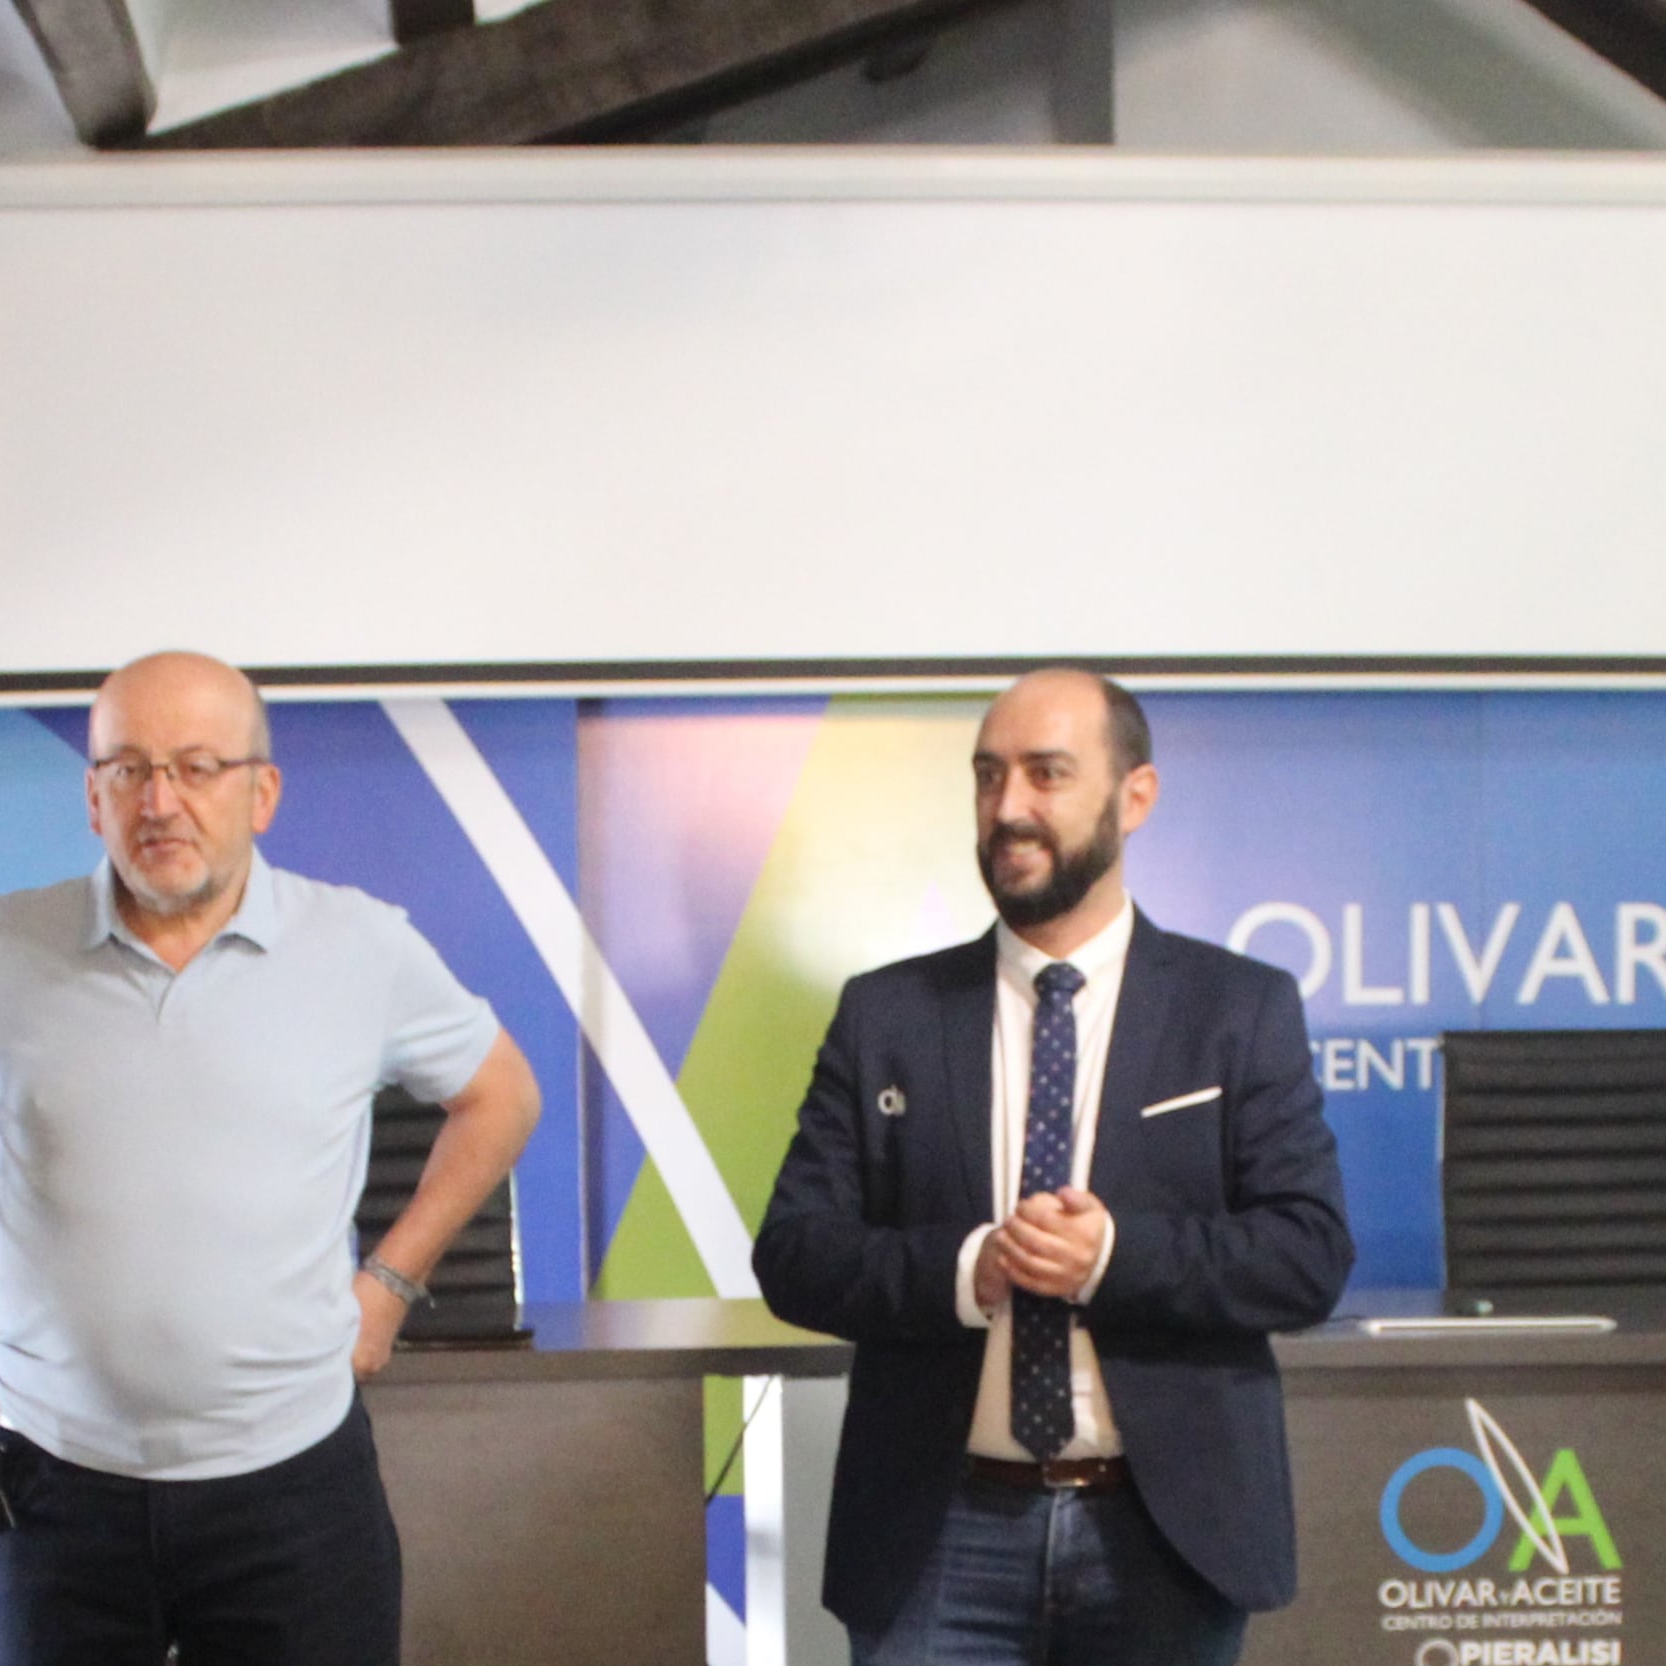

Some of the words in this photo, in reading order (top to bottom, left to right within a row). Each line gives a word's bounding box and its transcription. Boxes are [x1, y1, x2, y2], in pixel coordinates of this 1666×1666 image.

[1310, 1037, 1442, 1091] ENT
[1380, 1448, 1623, 1573] OA
[1379, 1580, 1497, 1608] OLIVAR
[1511, 1577, 1622, 1606] ACEITE
[1381, 1613, 1452, 1631] CENTRO
[1456, 1612, 1480, 1629] DE
[1482, 1609, 1623, 1628] INTERPRETACIÓN
[1459, 1639, 1622, 1666] PIERALISI
